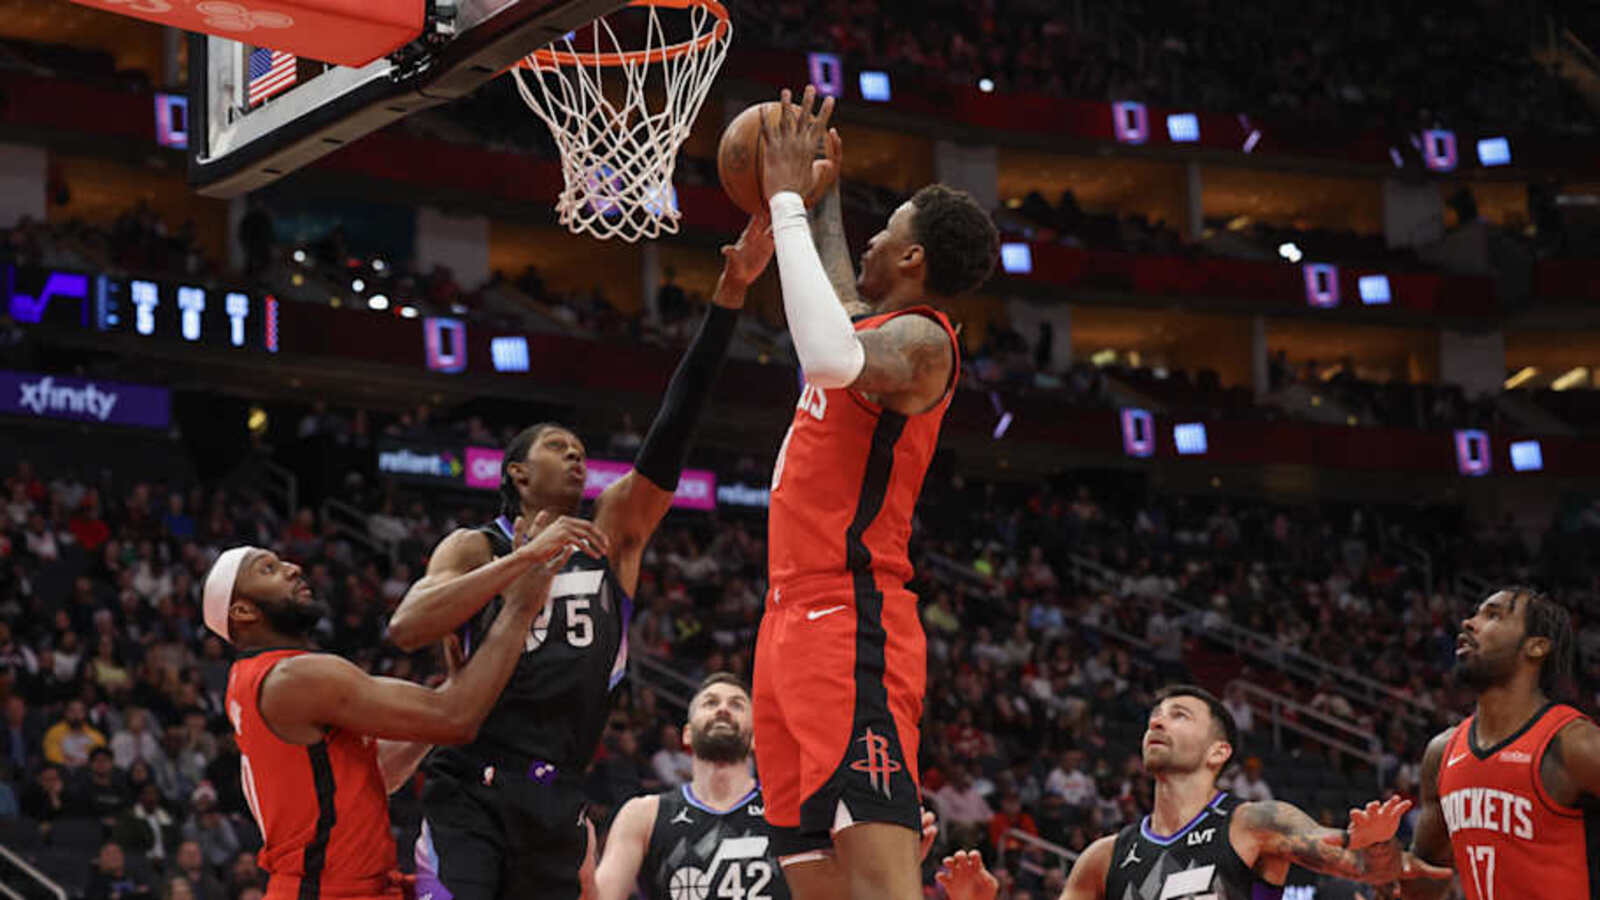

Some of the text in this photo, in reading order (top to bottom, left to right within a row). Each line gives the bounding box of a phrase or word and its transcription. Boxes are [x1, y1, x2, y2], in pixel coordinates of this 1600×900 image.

[20, 377, 116, 421] xfinity
[379, 449, 440, 476] reliant
[566, 599, 594, 648] 5
[747, 804, 765, 815] LV
[1187, 828, 1216, 846] LVT
[717, 860, 773, 900] 42
[1466, 845, 1496, 900] 17
